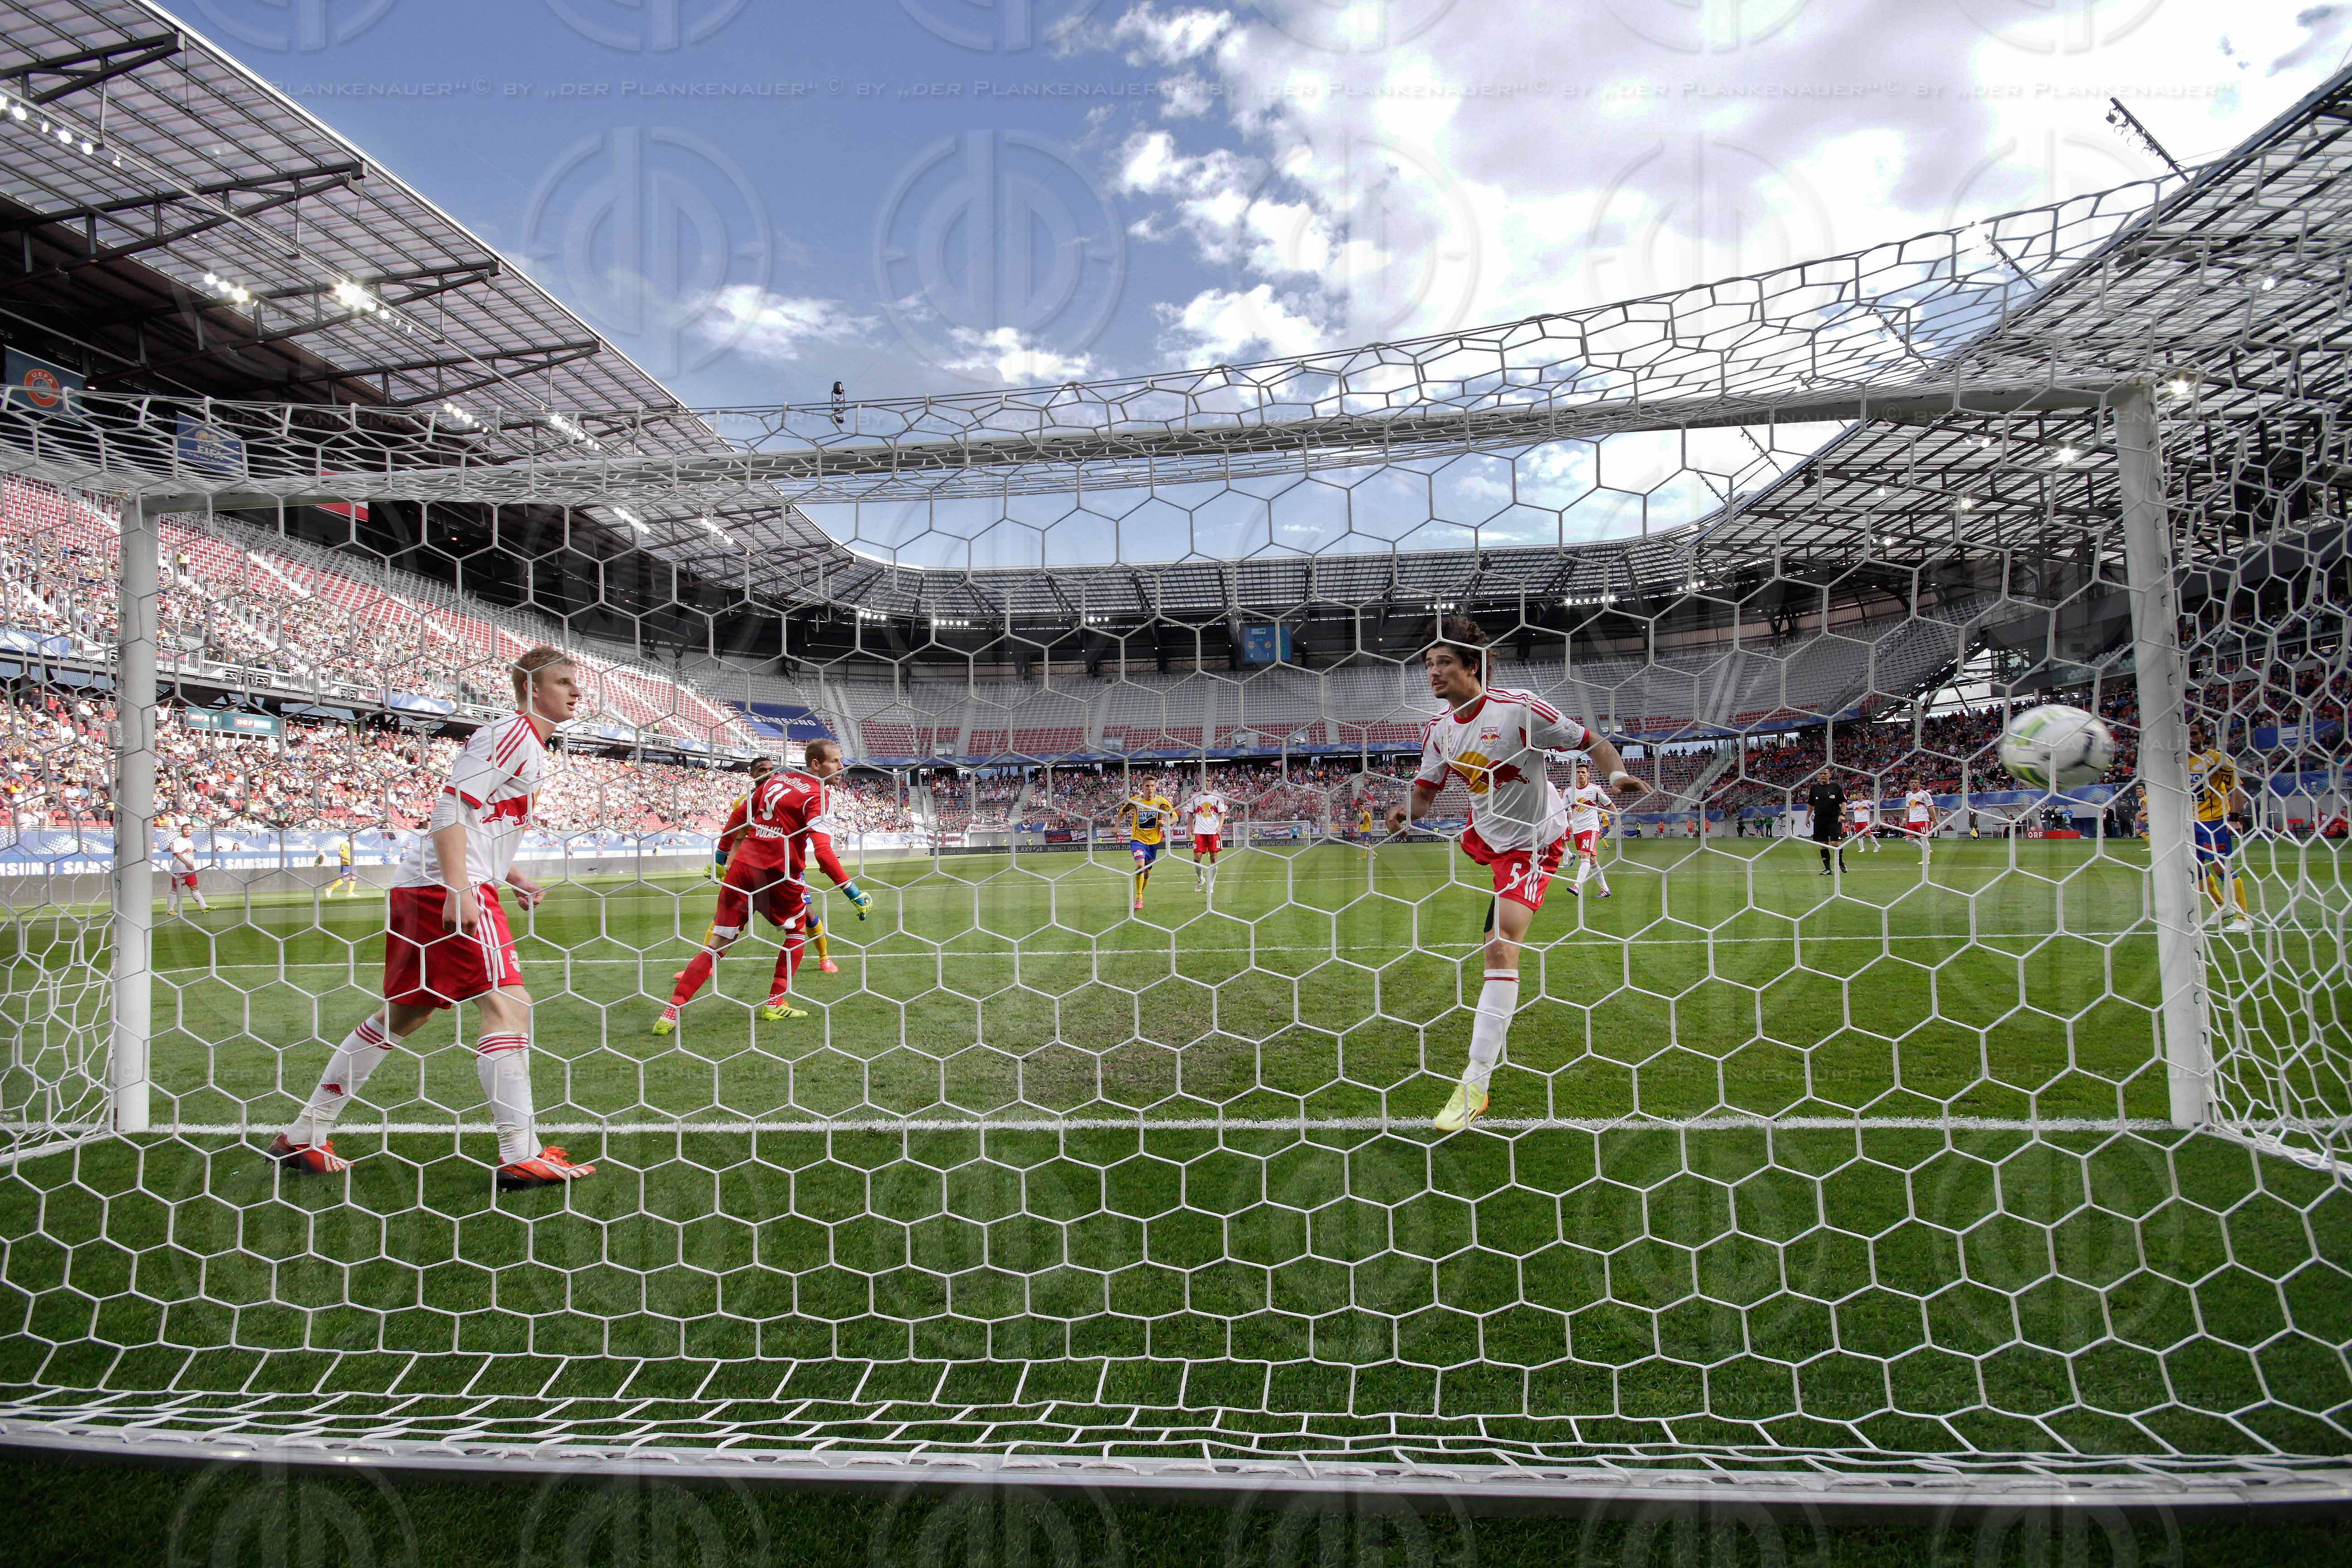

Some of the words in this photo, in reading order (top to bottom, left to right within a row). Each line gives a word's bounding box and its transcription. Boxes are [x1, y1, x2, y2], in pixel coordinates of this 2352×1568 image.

[31, 372, 54, 385] UEFA
[751, 715, 816, 726] SAMSUNG
[1582, 839, 1590, 849] 24
[1506, 862, 1522, 890] 5
